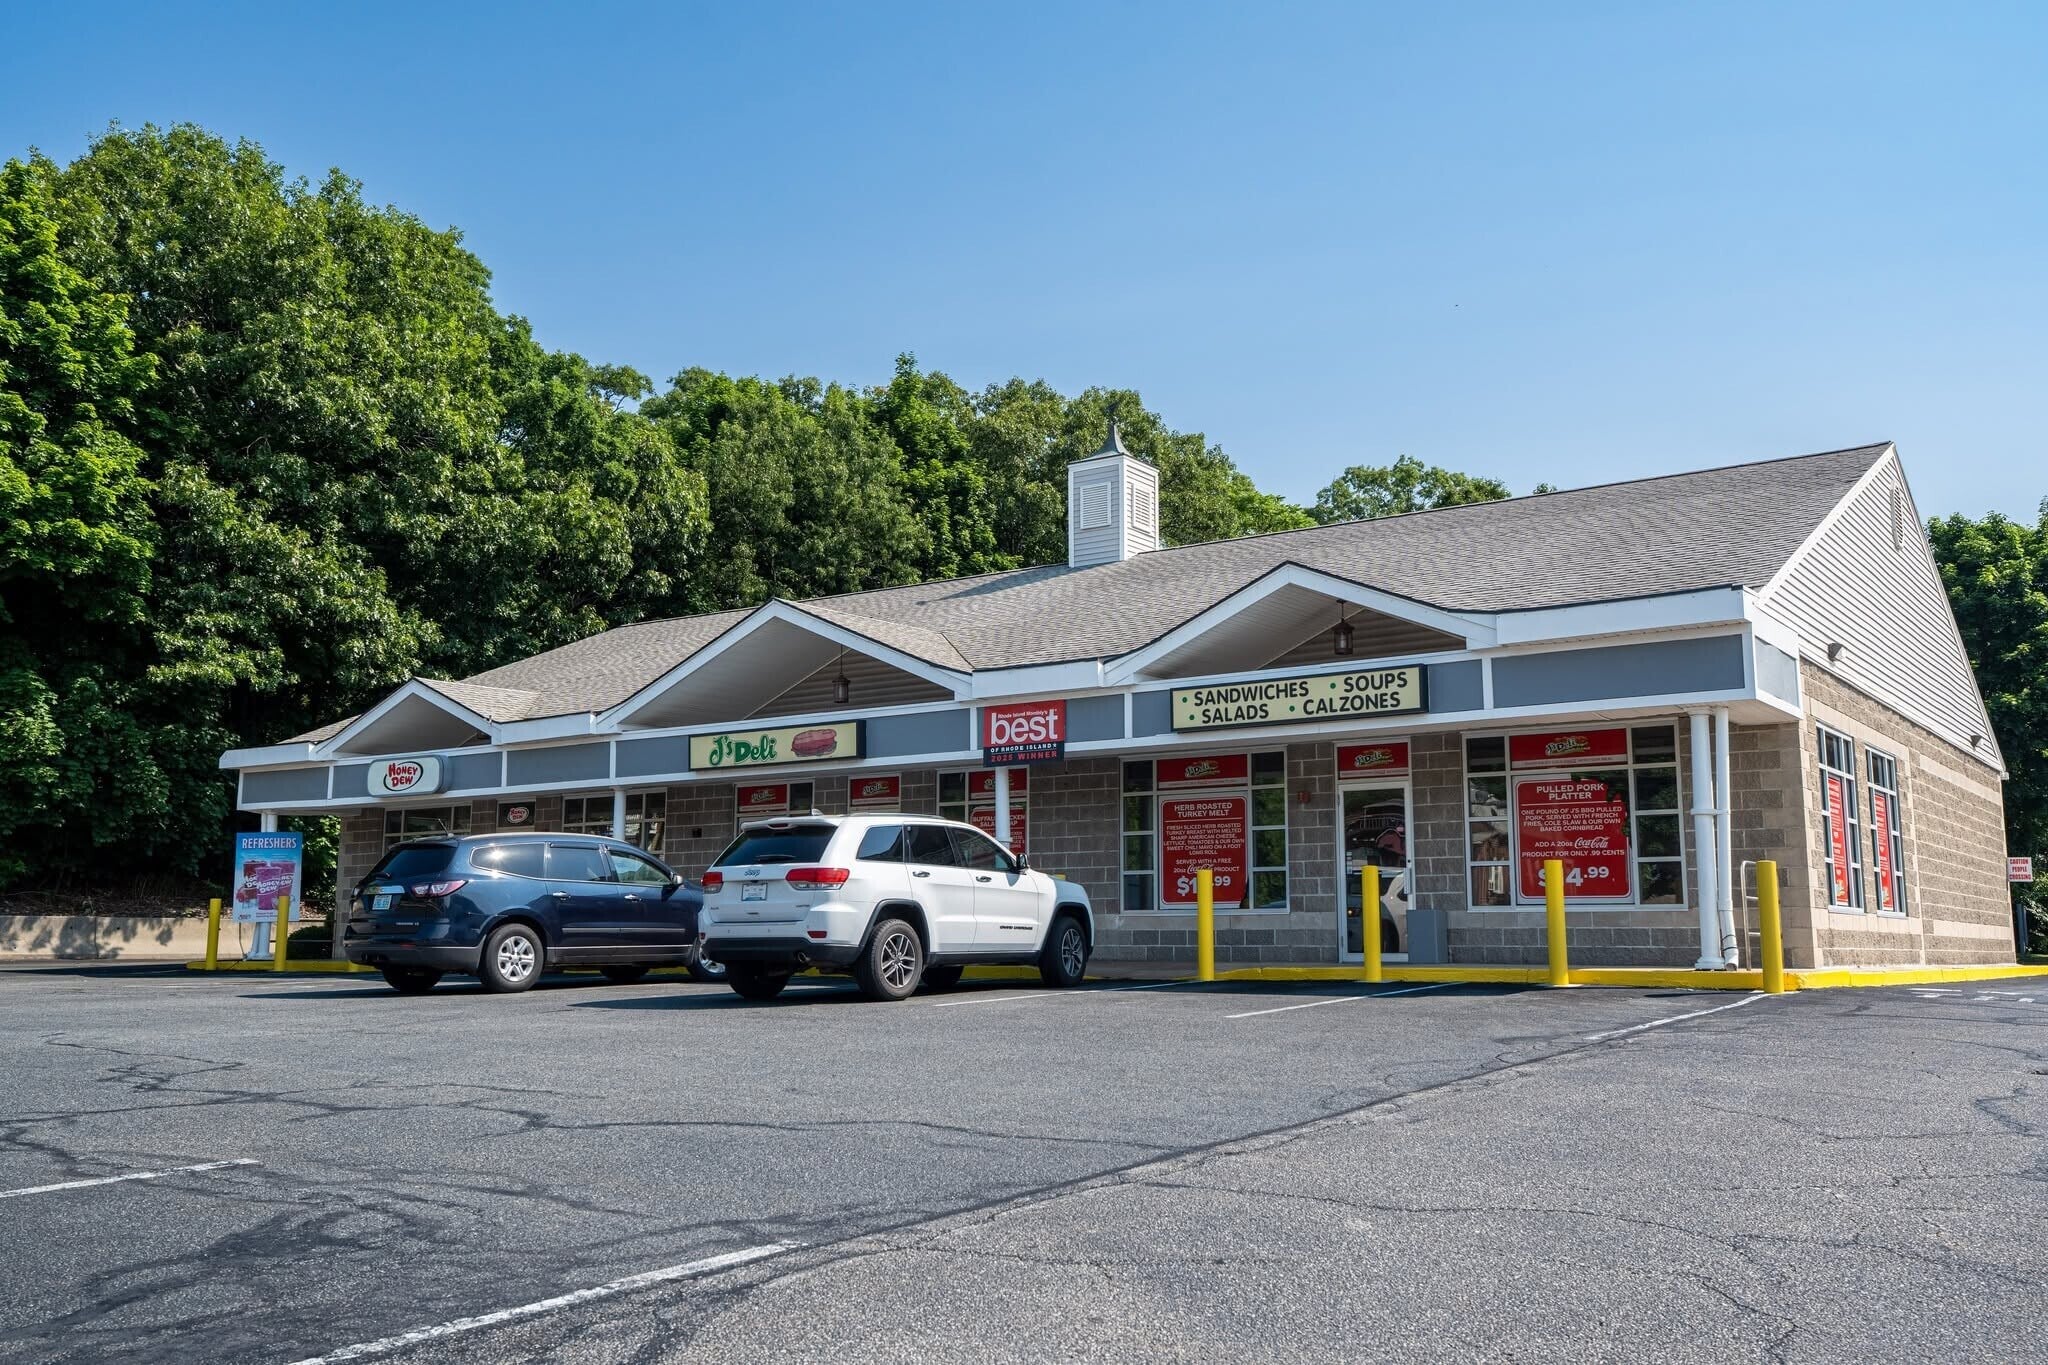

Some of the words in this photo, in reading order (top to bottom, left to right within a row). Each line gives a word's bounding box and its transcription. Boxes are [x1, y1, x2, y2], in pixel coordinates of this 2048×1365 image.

[1193, 681, 1310, 707] SANDWICHES
[1343, 671, 1408, 693] SOUPS
[1202, 703, 1269, 724] SALADS
[1303, 691, 1400, 715] CALZONES
[990, 708, 1058, 745] best
[709, 735, 733, 766] J's
[734, 734, 777, 764] Deli
[991, 754, 1014, 763] 2025
[1017, 750, 1057, 760] WINNER
[388, 763, 418, 777] HONEY
[391, 775, 414, 787] DEW
[1536, 785, 1574, 793] PULLED
[1576, 783, 1605, 792] PORK
[1549, 792, 1592, 800] PLATTER
[1196, 802, 1233, 810] ROASTED
[1178, 810, 1208, 818] TURKEY
[242, 837, 297, 849] REFRESHERS
[1176, 875, 1231, 897] $1.99
